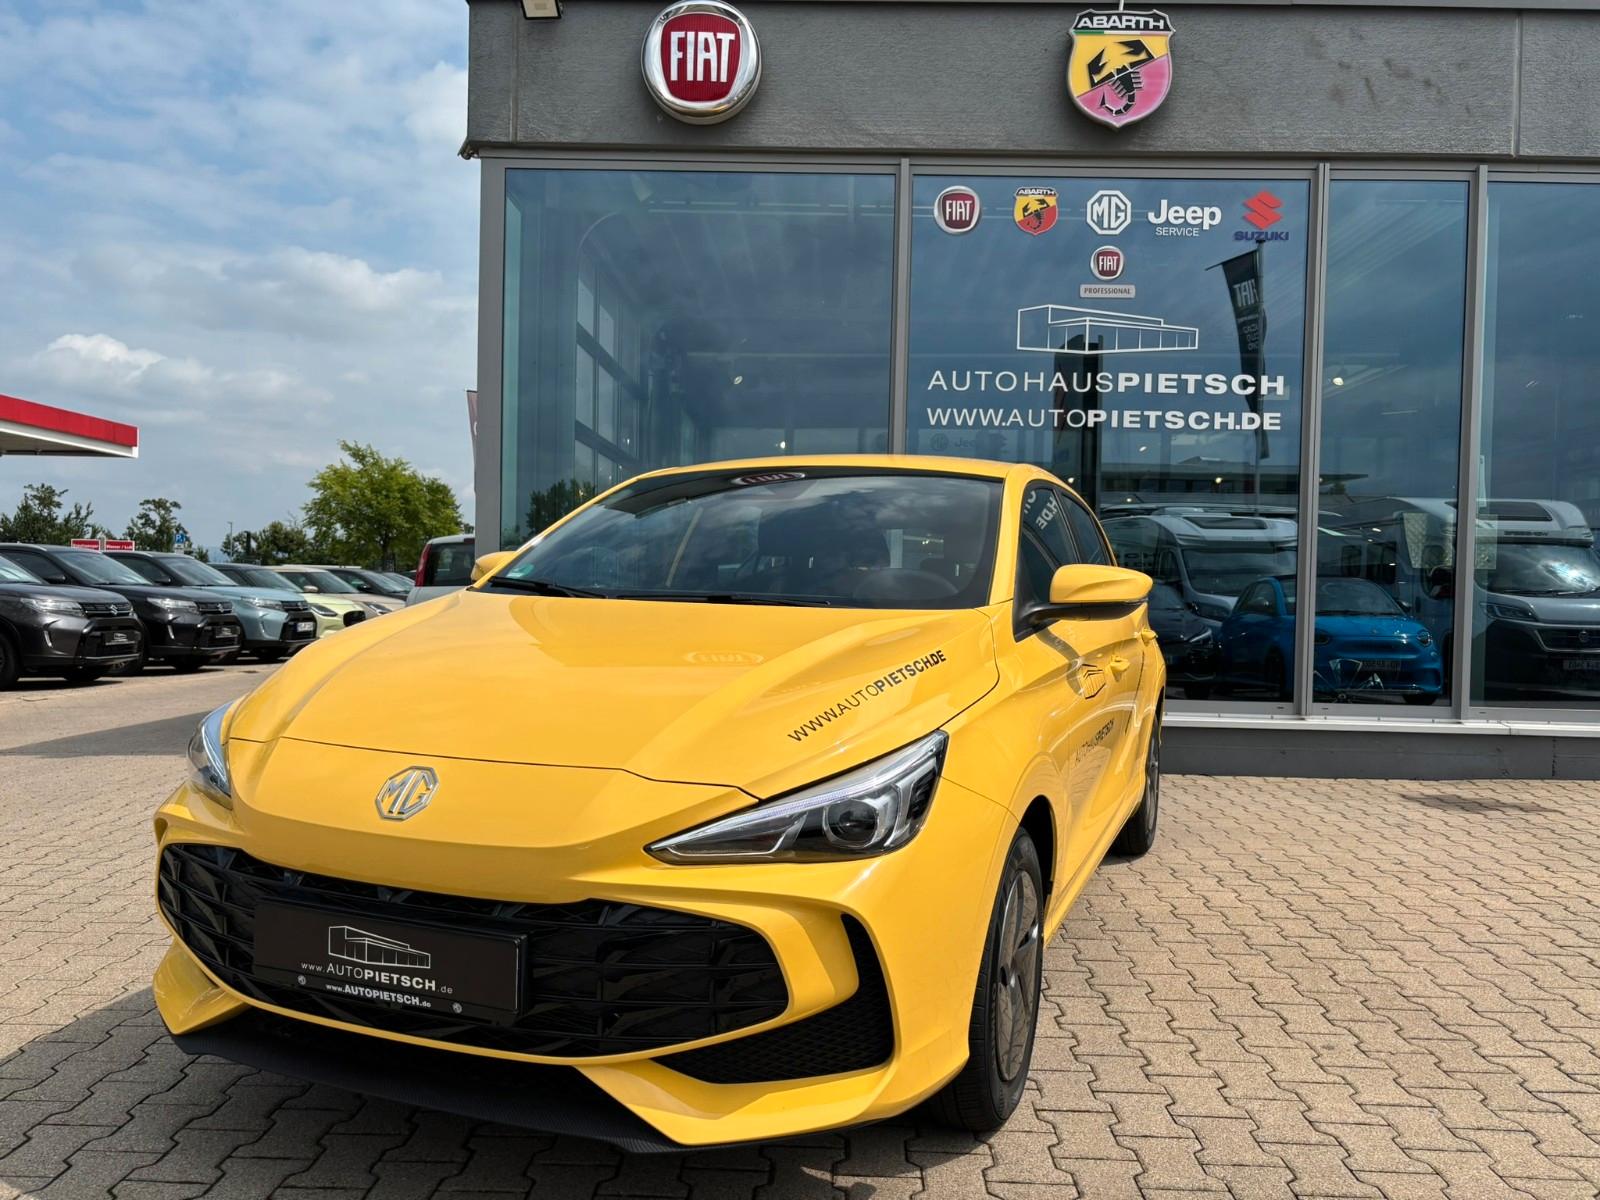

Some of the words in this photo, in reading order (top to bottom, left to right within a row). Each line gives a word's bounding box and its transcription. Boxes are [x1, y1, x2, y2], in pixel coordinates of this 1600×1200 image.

[1077, 16, 1164, 30] ABARTH
[670, 31, 736, 83] FIAT
[945, 200, 973, 221] FIAT
[1092, 195, 1126, 229] MG
[1147, 199, 1222, 230] Jeep
[1155, 227, 1200, 237] SERVICE
[1234, 231, 1290, 242] SUZUKI
[1099, 256, 1120, 272] FIAT
[1084, 287, 1132, 295] PROFESSIONAL
[927, 370, 1285, 396] AUTOHAUSPIETSCH
[927, 407, 1282, 431] WWW.AUTOPIETSCH.DE
[787, 650, 947, 742] WWW.AUTOPIETSCH.DE
[380, 769, 435, 815] MG
[301, 962, 453, 994] www.AUTOPIETSCH.de
[326, 984, 432, 1008] www.AUTOPIETSCH.de
